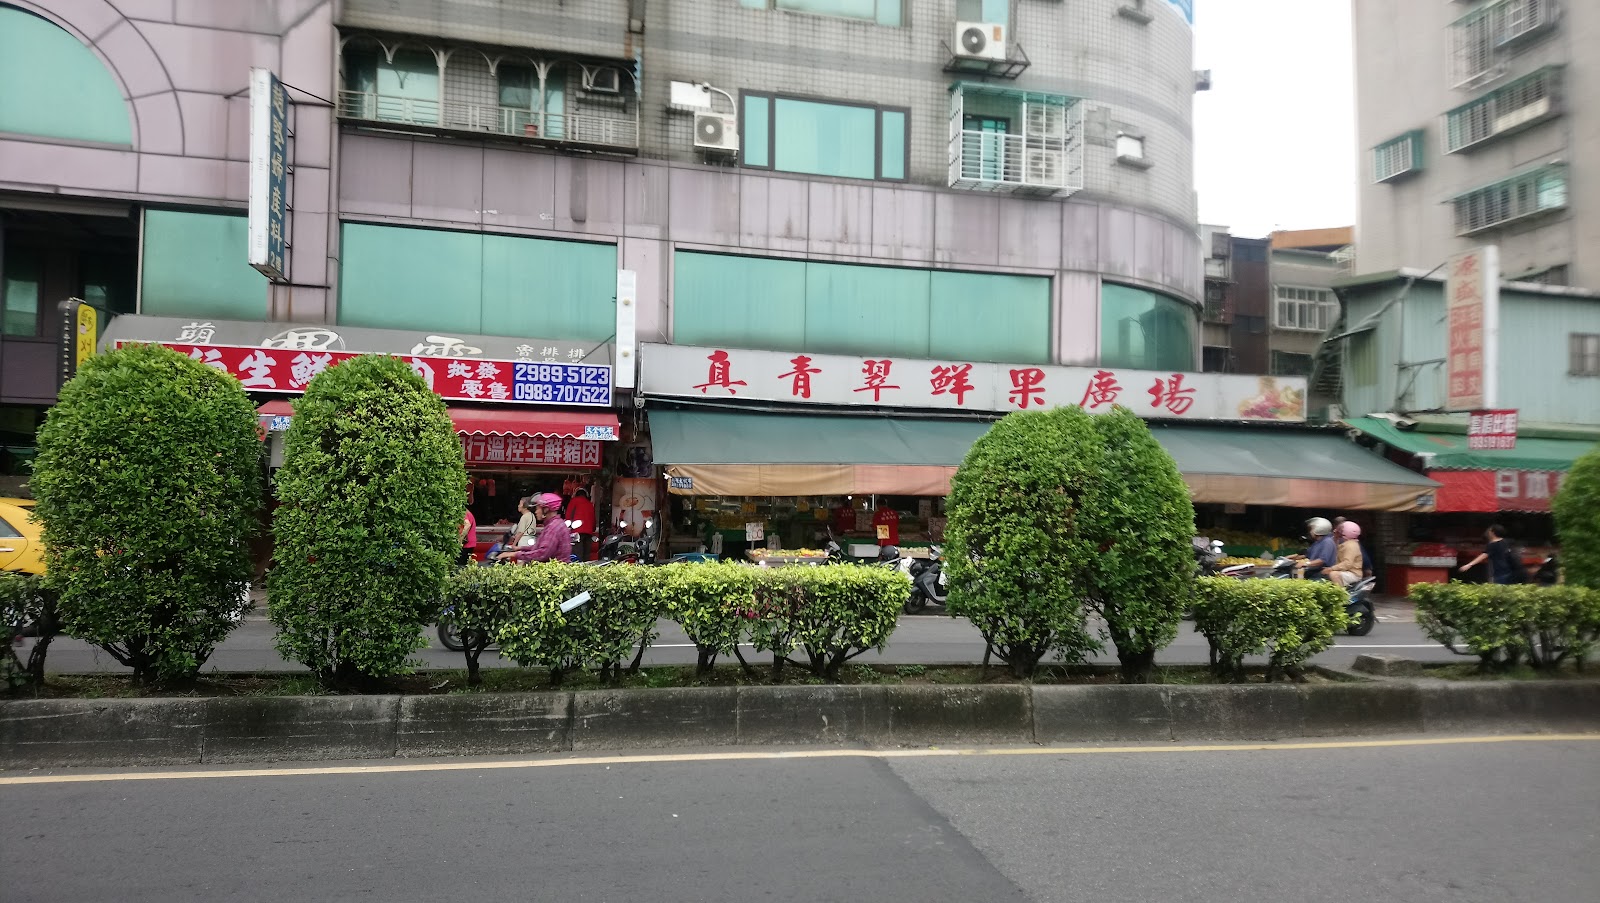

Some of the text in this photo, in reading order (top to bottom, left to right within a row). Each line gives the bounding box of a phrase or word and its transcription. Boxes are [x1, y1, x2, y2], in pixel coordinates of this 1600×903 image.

[447, 361, 501, 380] 批發
[515, 364, 609, 385] 2989-5123
[460, 379, 510, 400] 零售
[692, 350, 1197, 415] 真青翠鮮果廣場
[515, 384, 608, 404] 0983-707522
[460, 436, 600, 464] 行溫控生鮮豬肉
